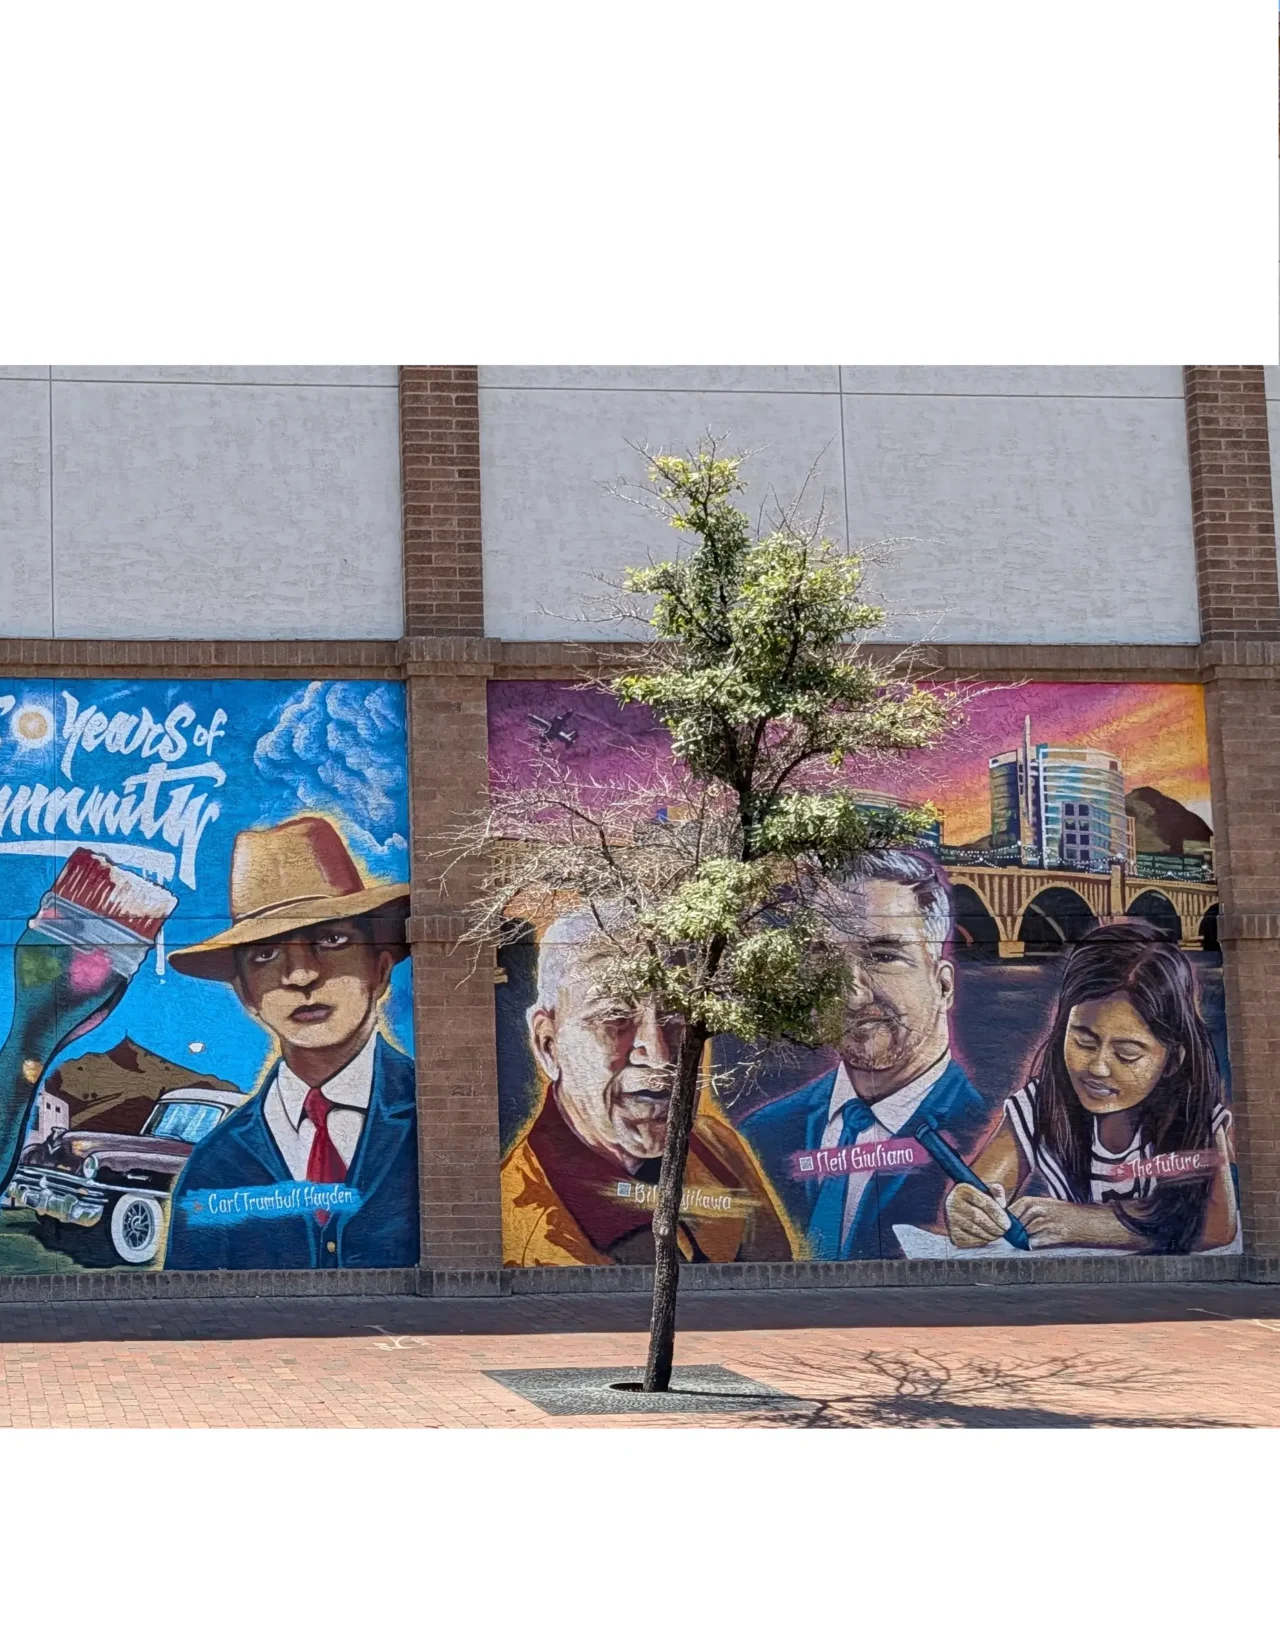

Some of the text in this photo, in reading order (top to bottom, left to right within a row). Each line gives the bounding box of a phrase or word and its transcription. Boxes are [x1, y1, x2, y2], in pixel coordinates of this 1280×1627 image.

[61, 690, 197, 781] Years
[192, 708, 227, 756] of
[816, 1144, 914, 1173] Neil Giuliano
[1127, 1158, 1153, 1178] The
[208, 1184, 353, 1215] Carl Trumbull Hayden
[634, 1182, 732, 1211] Bil ujikawa
